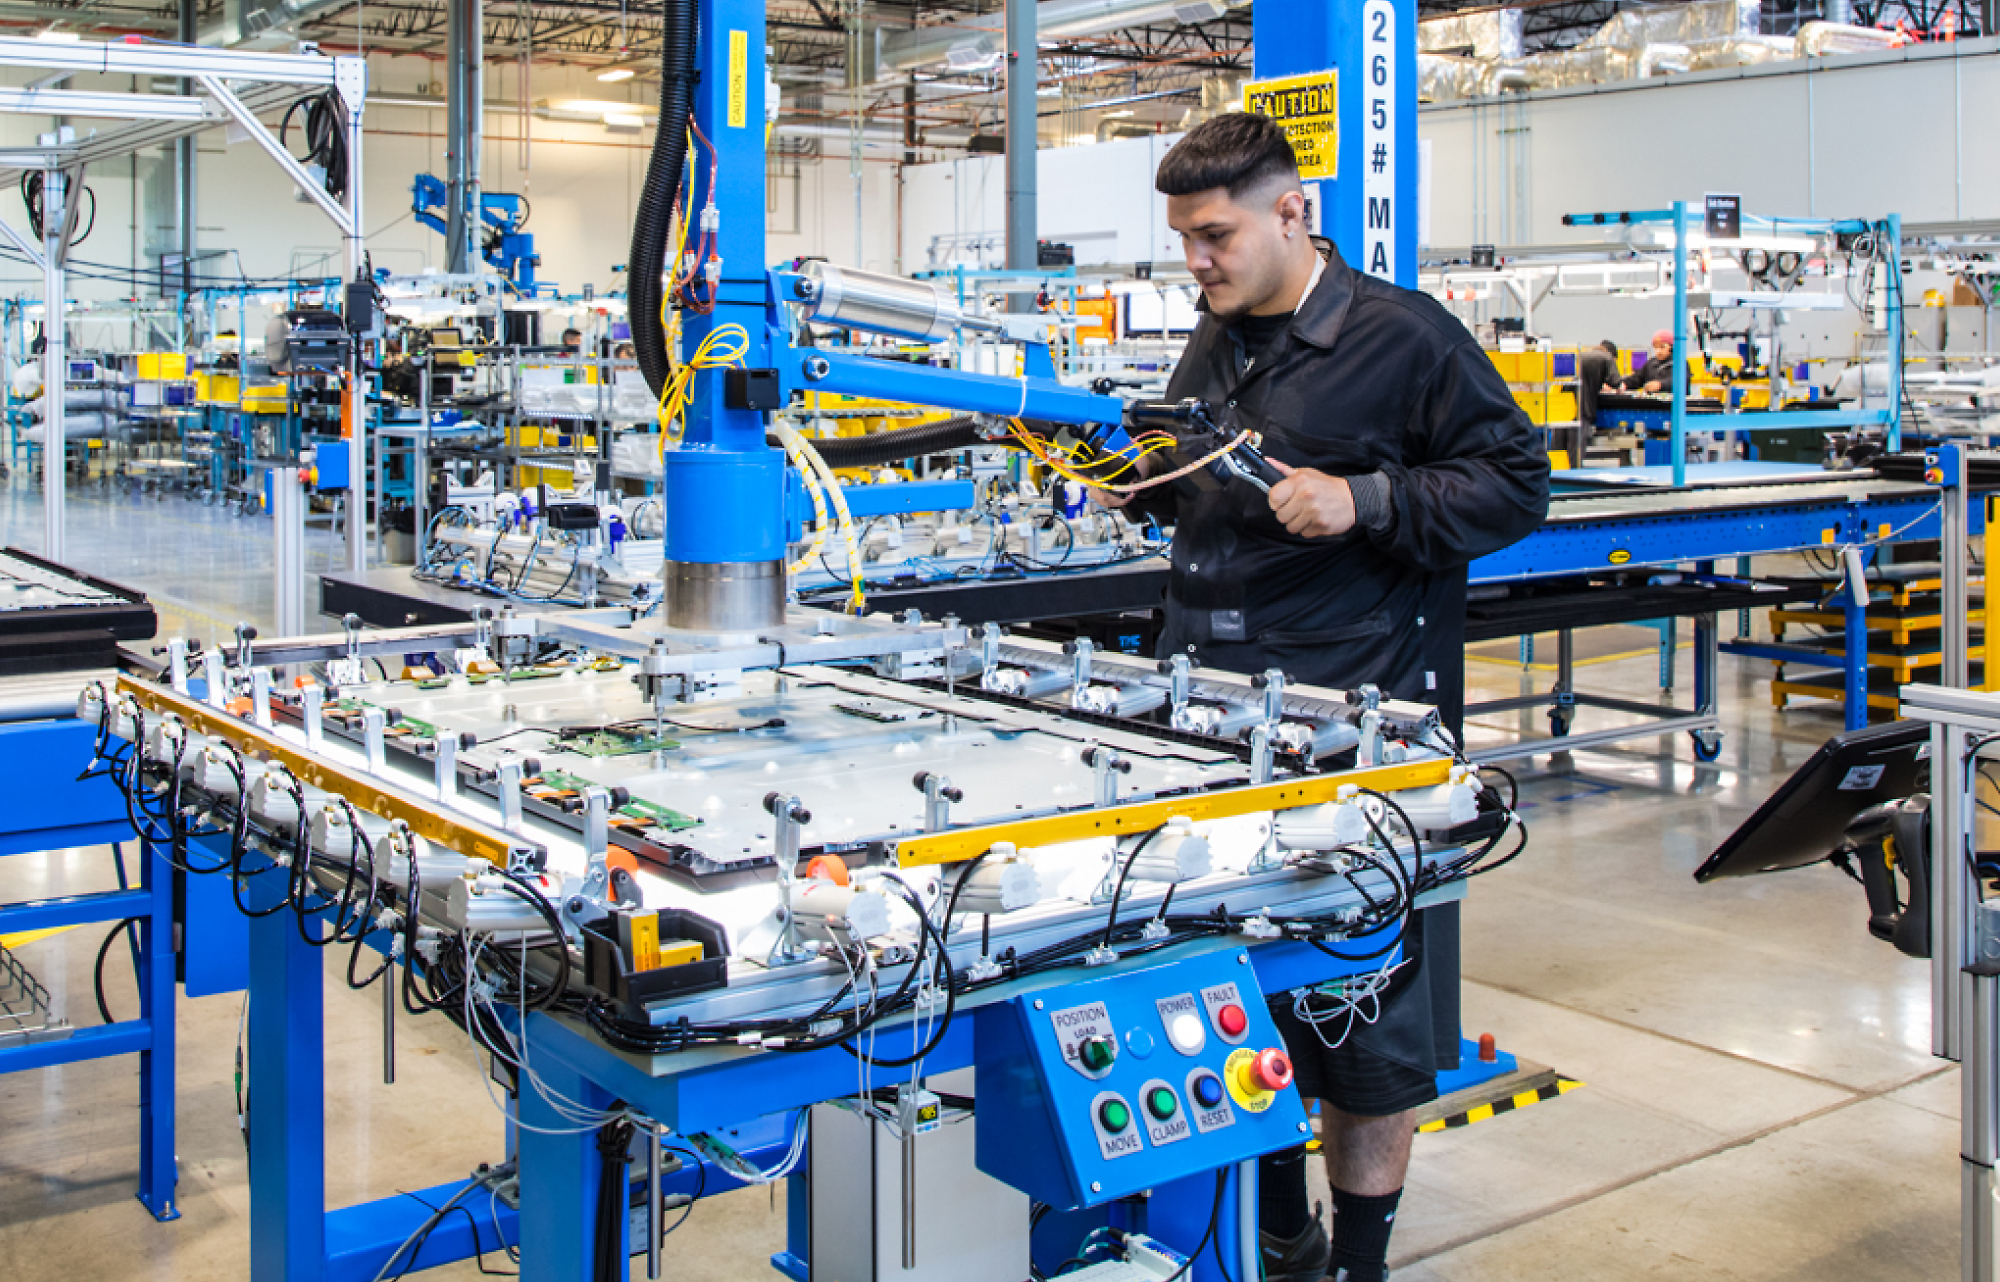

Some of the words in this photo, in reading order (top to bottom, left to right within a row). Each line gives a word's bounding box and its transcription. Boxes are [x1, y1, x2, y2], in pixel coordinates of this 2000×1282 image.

[732, 74, 742, 124] CAUTION
[1251, 85, 1333, 118] CAUTION
[1371, 10, 1388, 174] 265#
[1287, 121, 1334, 136] OTECTION
[1295, 138, 1315, 150] RED
[1206, 986, 1235, 1003] FAULT
[1159, 996, 1197, 1014] POWER
[1056, 1006, 1105, 1027] POSITION
[1074, 1026, 1097, 1038] LOAD
[1199, 1108, 1230, 1127] RESET
[1152, 1120, 1187, 1141] CLAMP
[1105, 1133, 1138, 1154] MOVE
